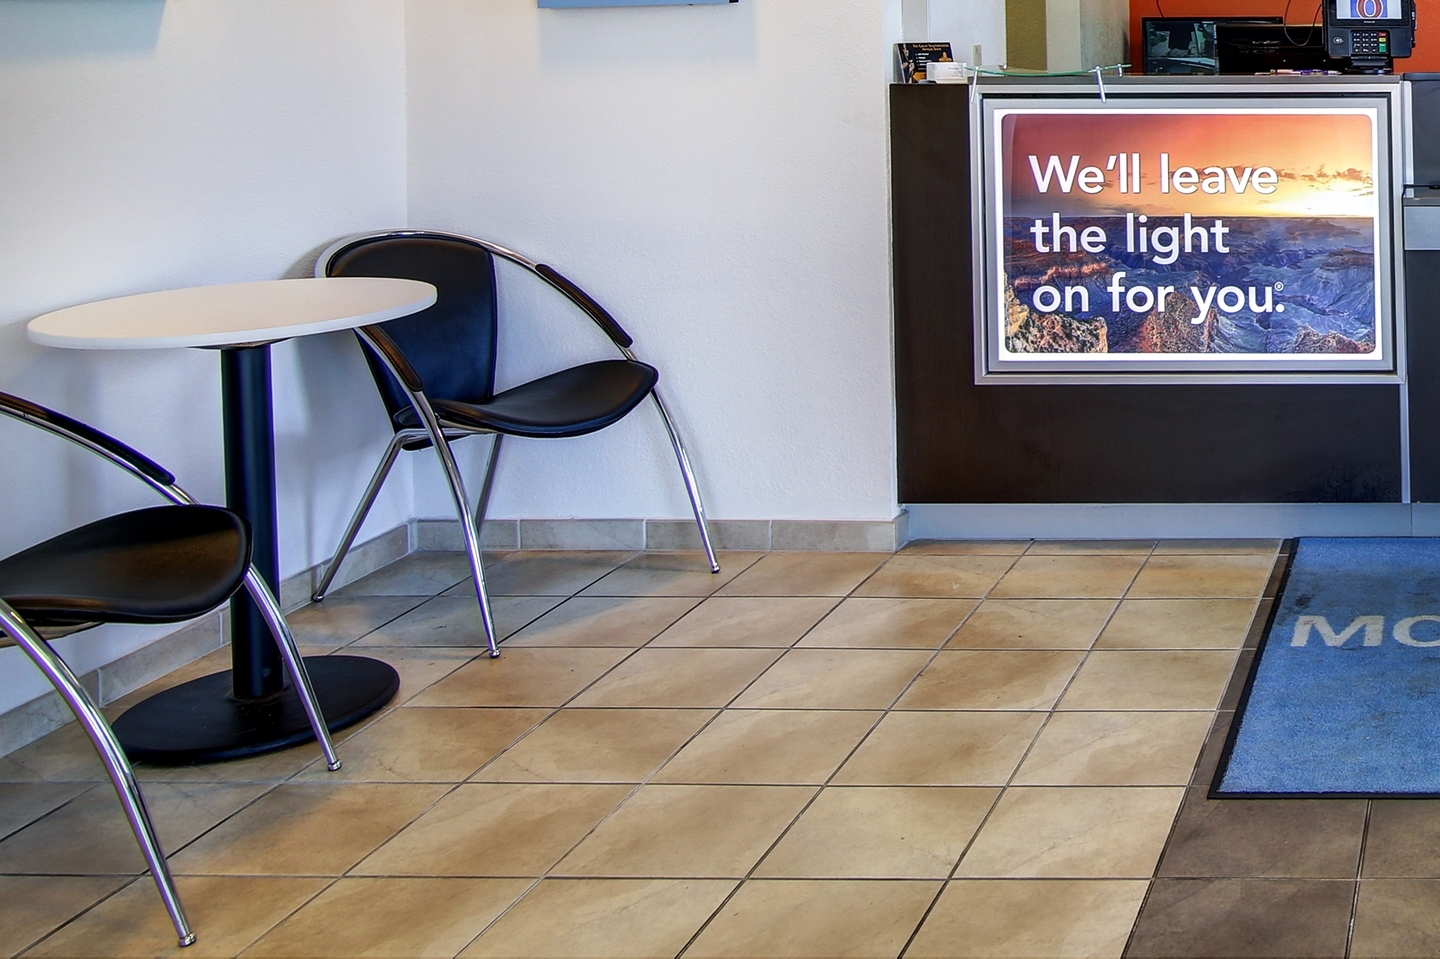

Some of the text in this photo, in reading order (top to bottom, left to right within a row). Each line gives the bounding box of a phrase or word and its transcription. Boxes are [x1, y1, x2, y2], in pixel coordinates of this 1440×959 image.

[1028, 152, 1278, 195] We'll leave
[1030, 212, 1229, 265] the light
[1033, 283, 1089, 313] on
[1107, 271, 1172, 313] for
